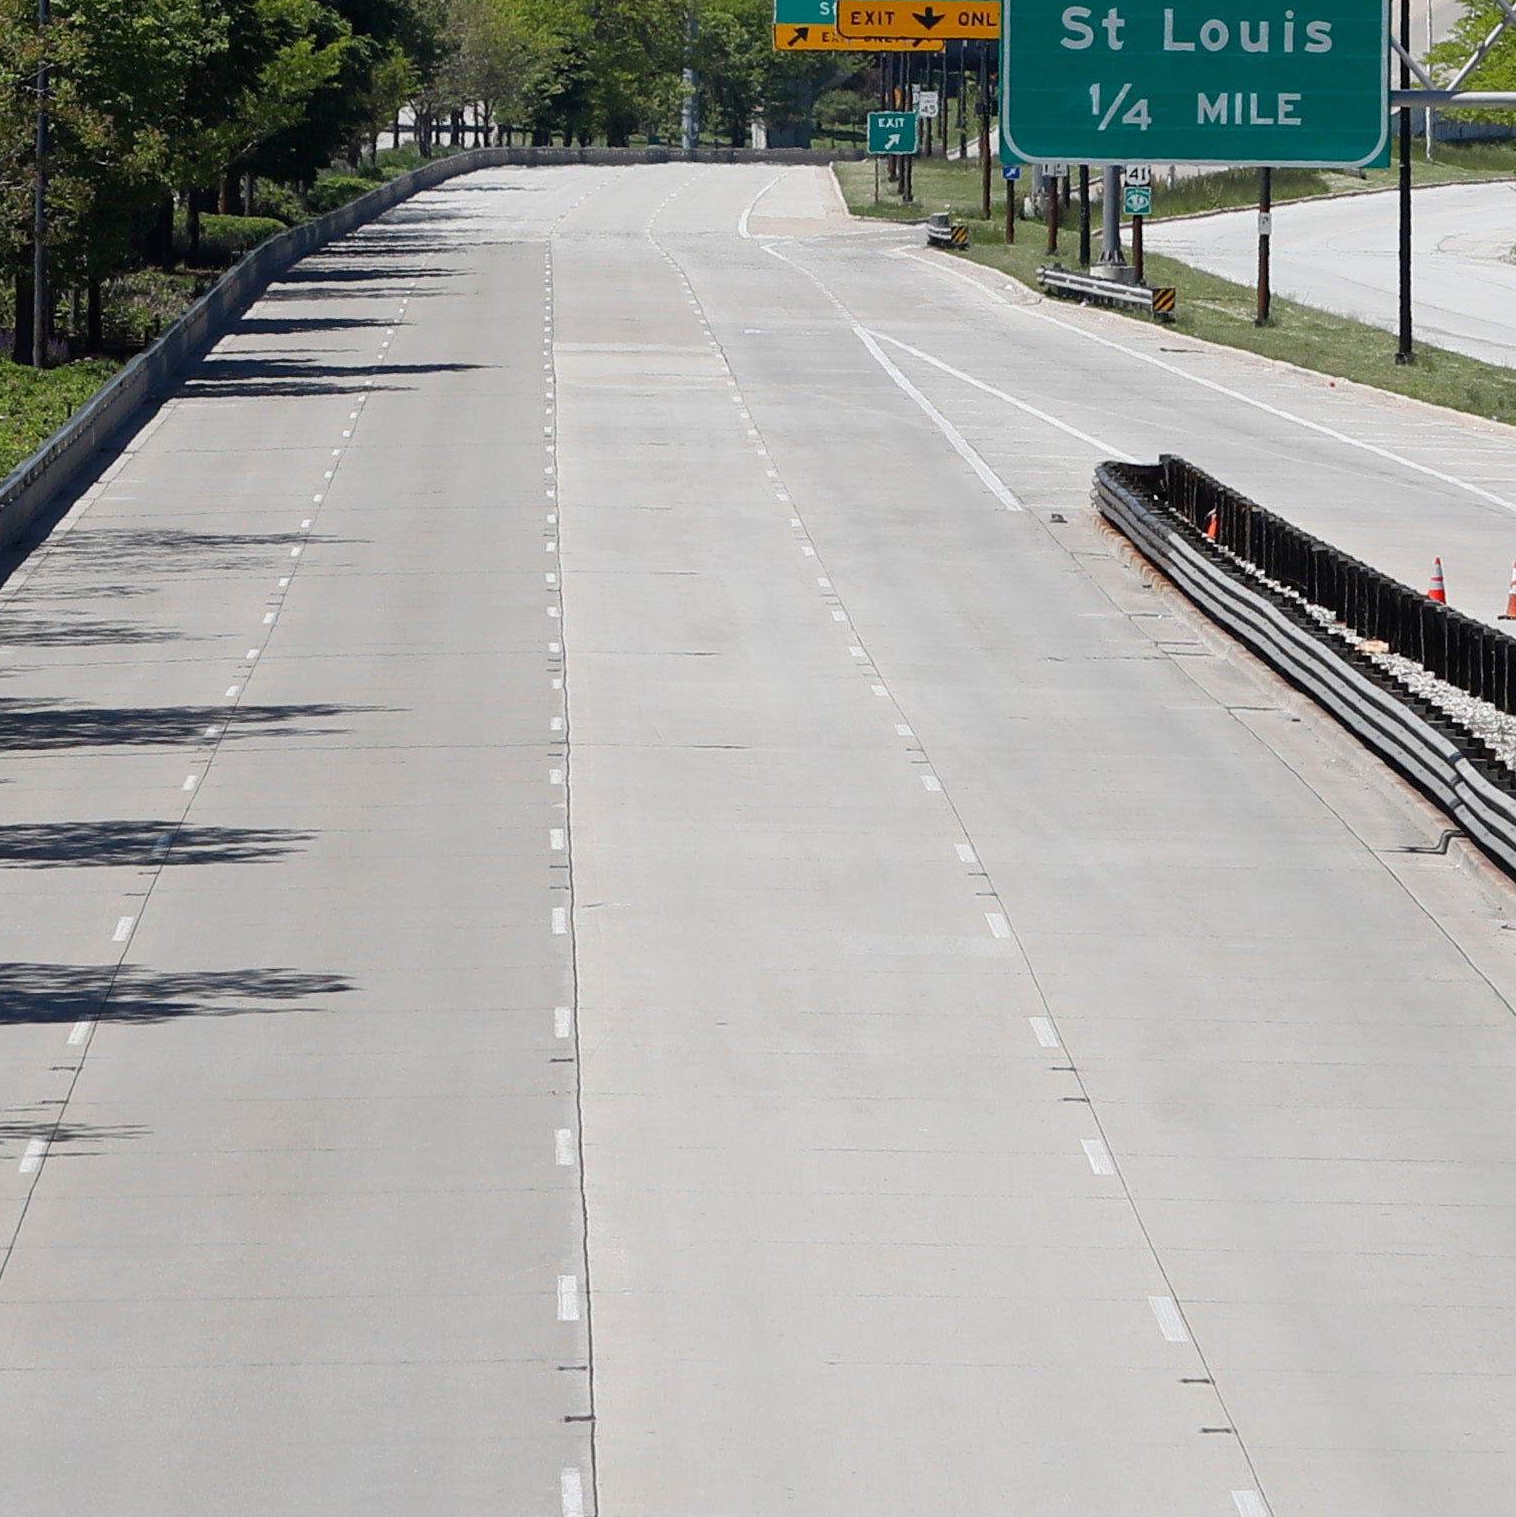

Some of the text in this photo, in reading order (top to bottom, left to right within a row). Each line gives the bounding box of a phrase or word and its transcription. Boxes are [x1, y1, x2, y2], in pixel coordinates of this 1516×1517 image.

[851, 11, 895, 25] EXIT
[958, 11, 1000, 27] ONL
[1060, 5, 1333, 53] St Louis
[1089, 83, 1303, 131] 1/4 MILE
[878, 118, 905, 128] EXIT
[1129, 167, 1146, 181] 41
